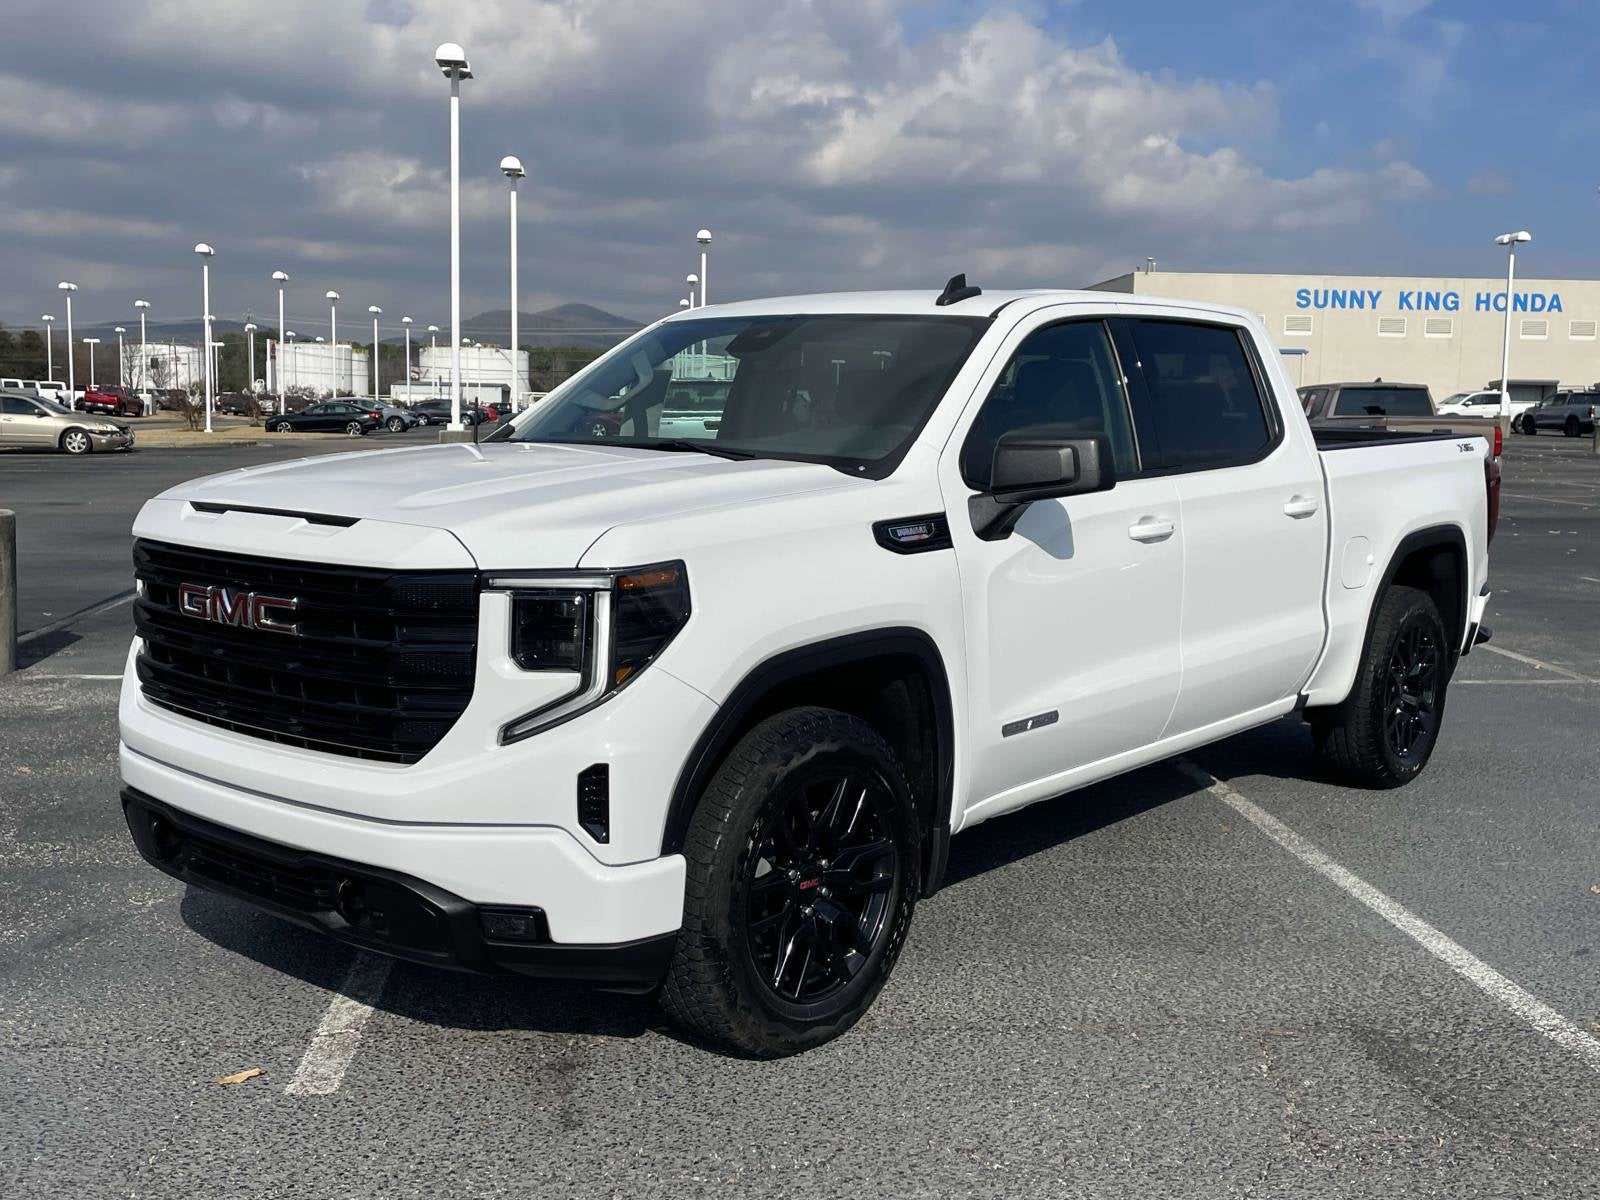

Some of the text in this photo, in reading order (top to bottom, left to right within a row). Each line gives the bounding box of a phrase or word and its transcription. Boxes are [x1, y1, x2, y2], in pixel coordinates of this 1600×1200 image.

[1295, 288, 1563, 312] SUNNY KING HONDA
[179, 582, 297, 636] GMC
[800, 879, 818, 890] GMC
